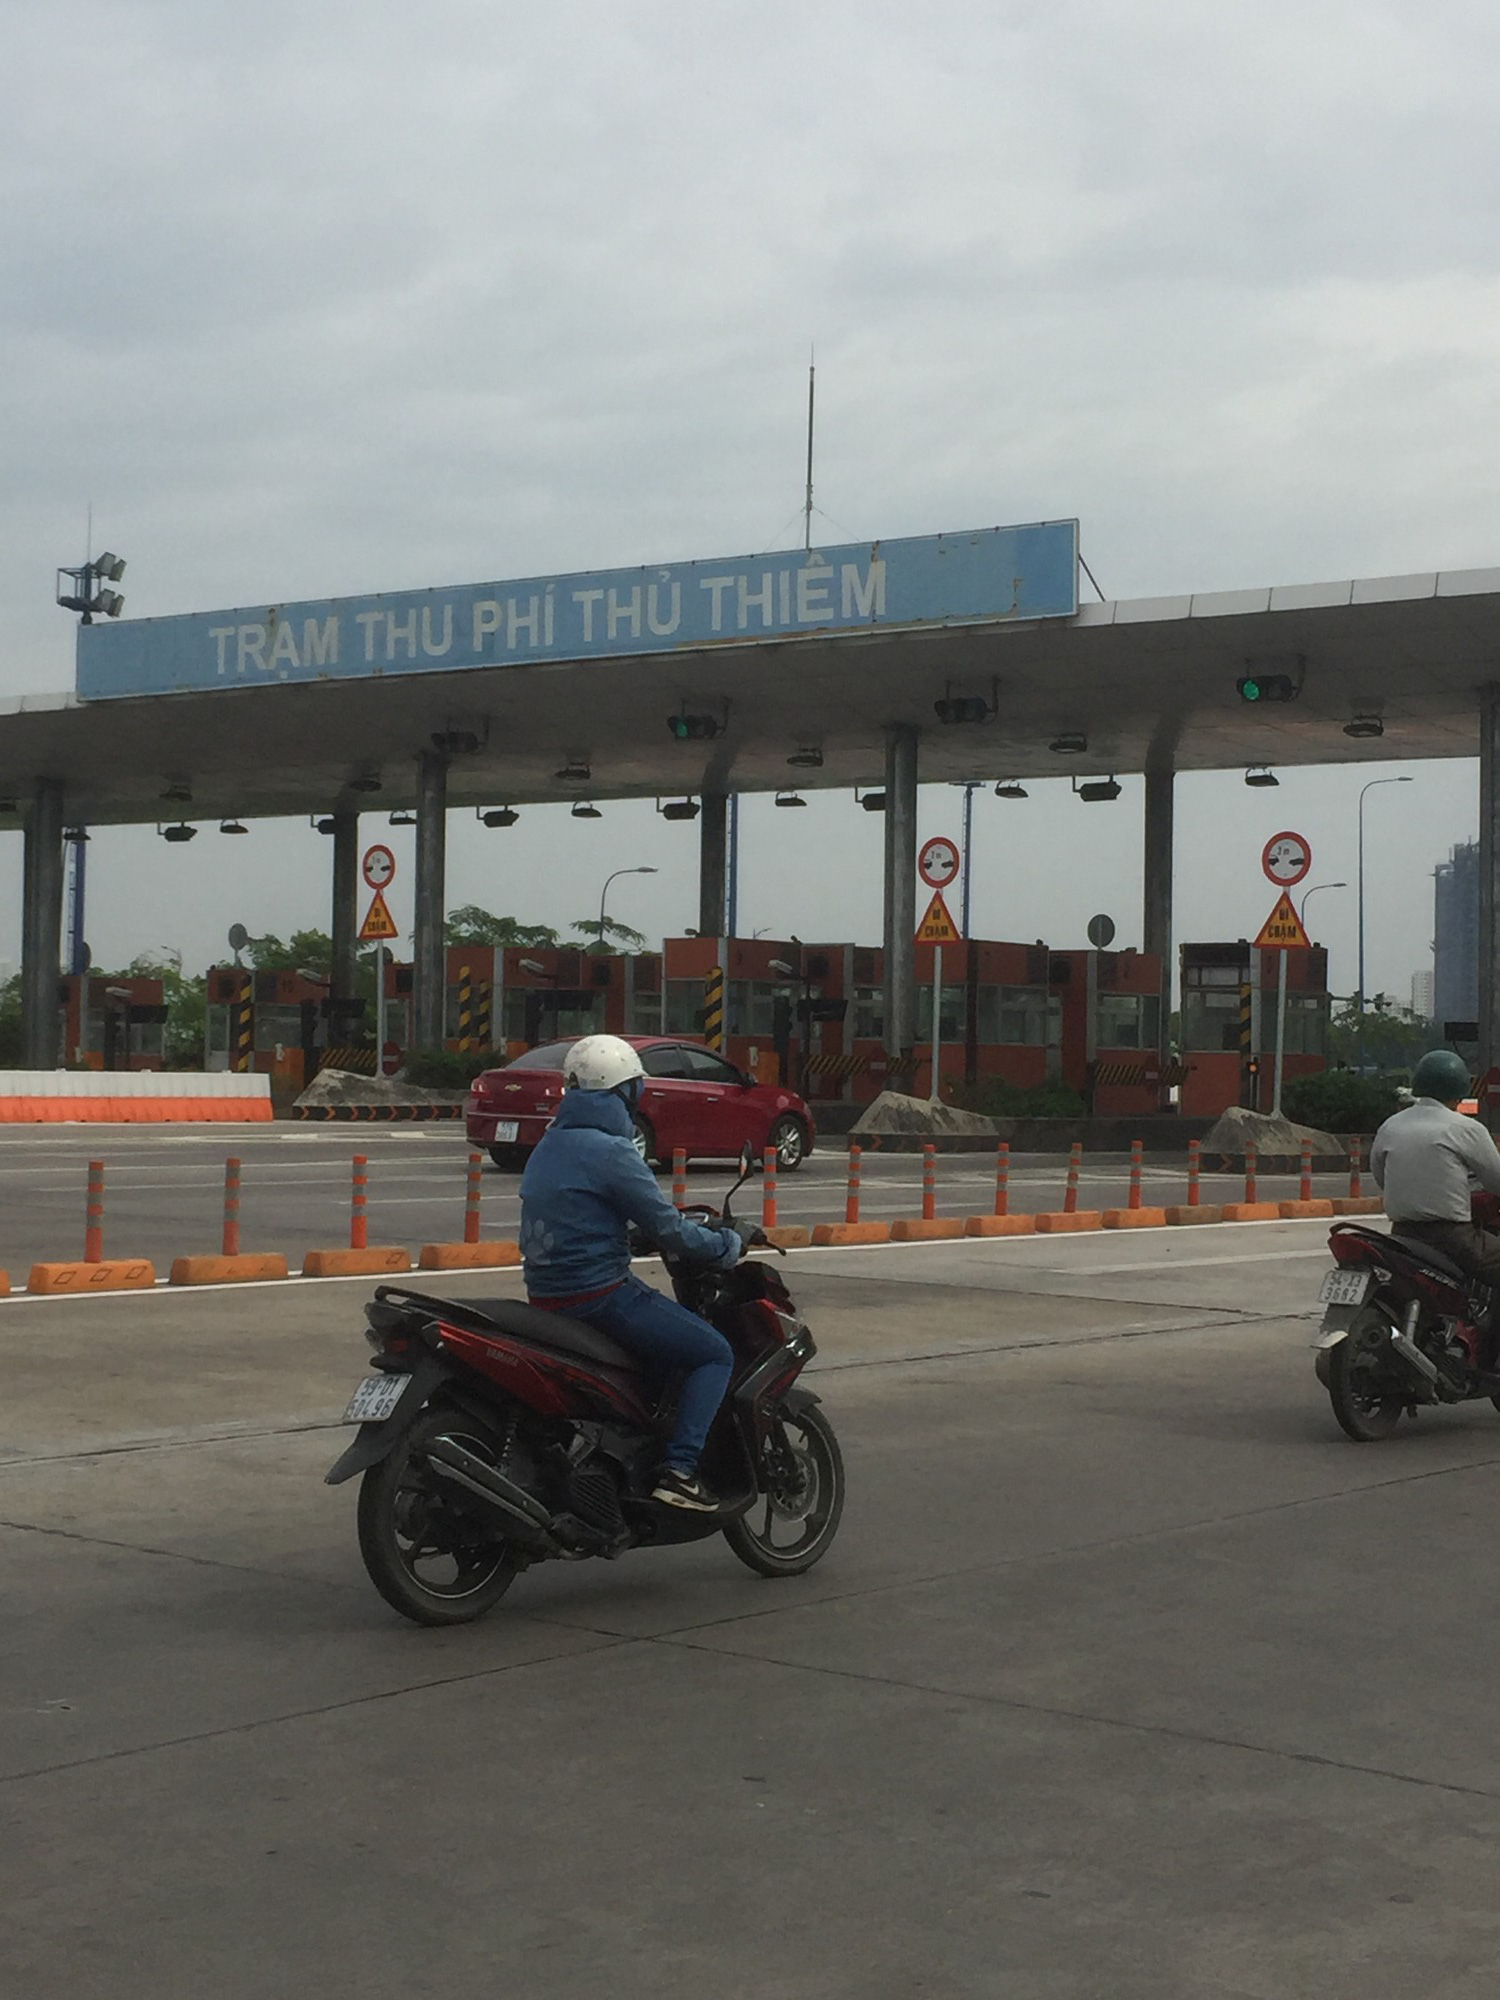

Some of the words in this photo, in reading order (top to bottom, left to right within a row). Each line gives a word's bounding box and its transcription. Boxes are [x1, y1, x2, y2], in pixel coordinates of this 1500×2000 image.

[209, 616, 340, 679] TRẠM
[356, 604, 453, 660] THU
[473, 584, 554, 652] PHÍ
[572, 571, 681, 642] THỦ
[700, 554, 886, 631] THIÊM
